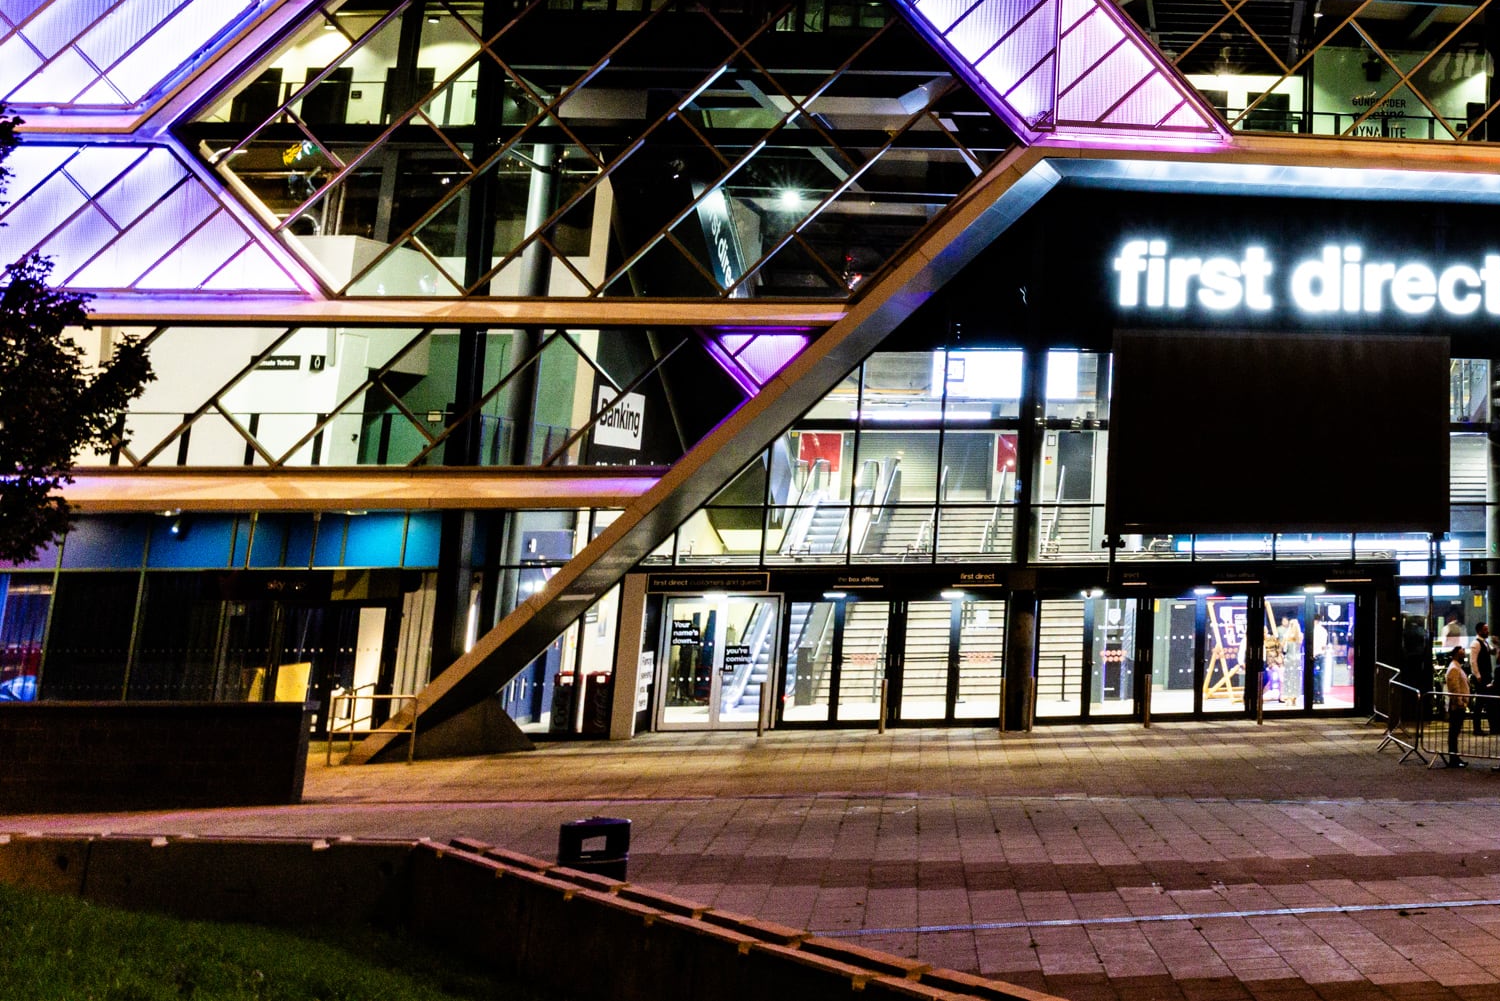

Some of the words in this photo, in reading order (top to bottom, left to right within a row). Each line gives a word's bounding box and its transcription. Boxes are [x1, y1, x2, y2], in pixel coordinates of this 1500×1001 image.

[1114, 240, 1273, 310] first
[600, 398, 641, 438] Banking
[977, 572, 995, 580] direct
[653, 578, 668, 586] first
[669, 578, 688, 586] direct
[674, 621, 691, 629] Your
[673, 629, 699, 637] name's
[672, 637, 699, 645] down...
[726, 647, 748, 656] you're
